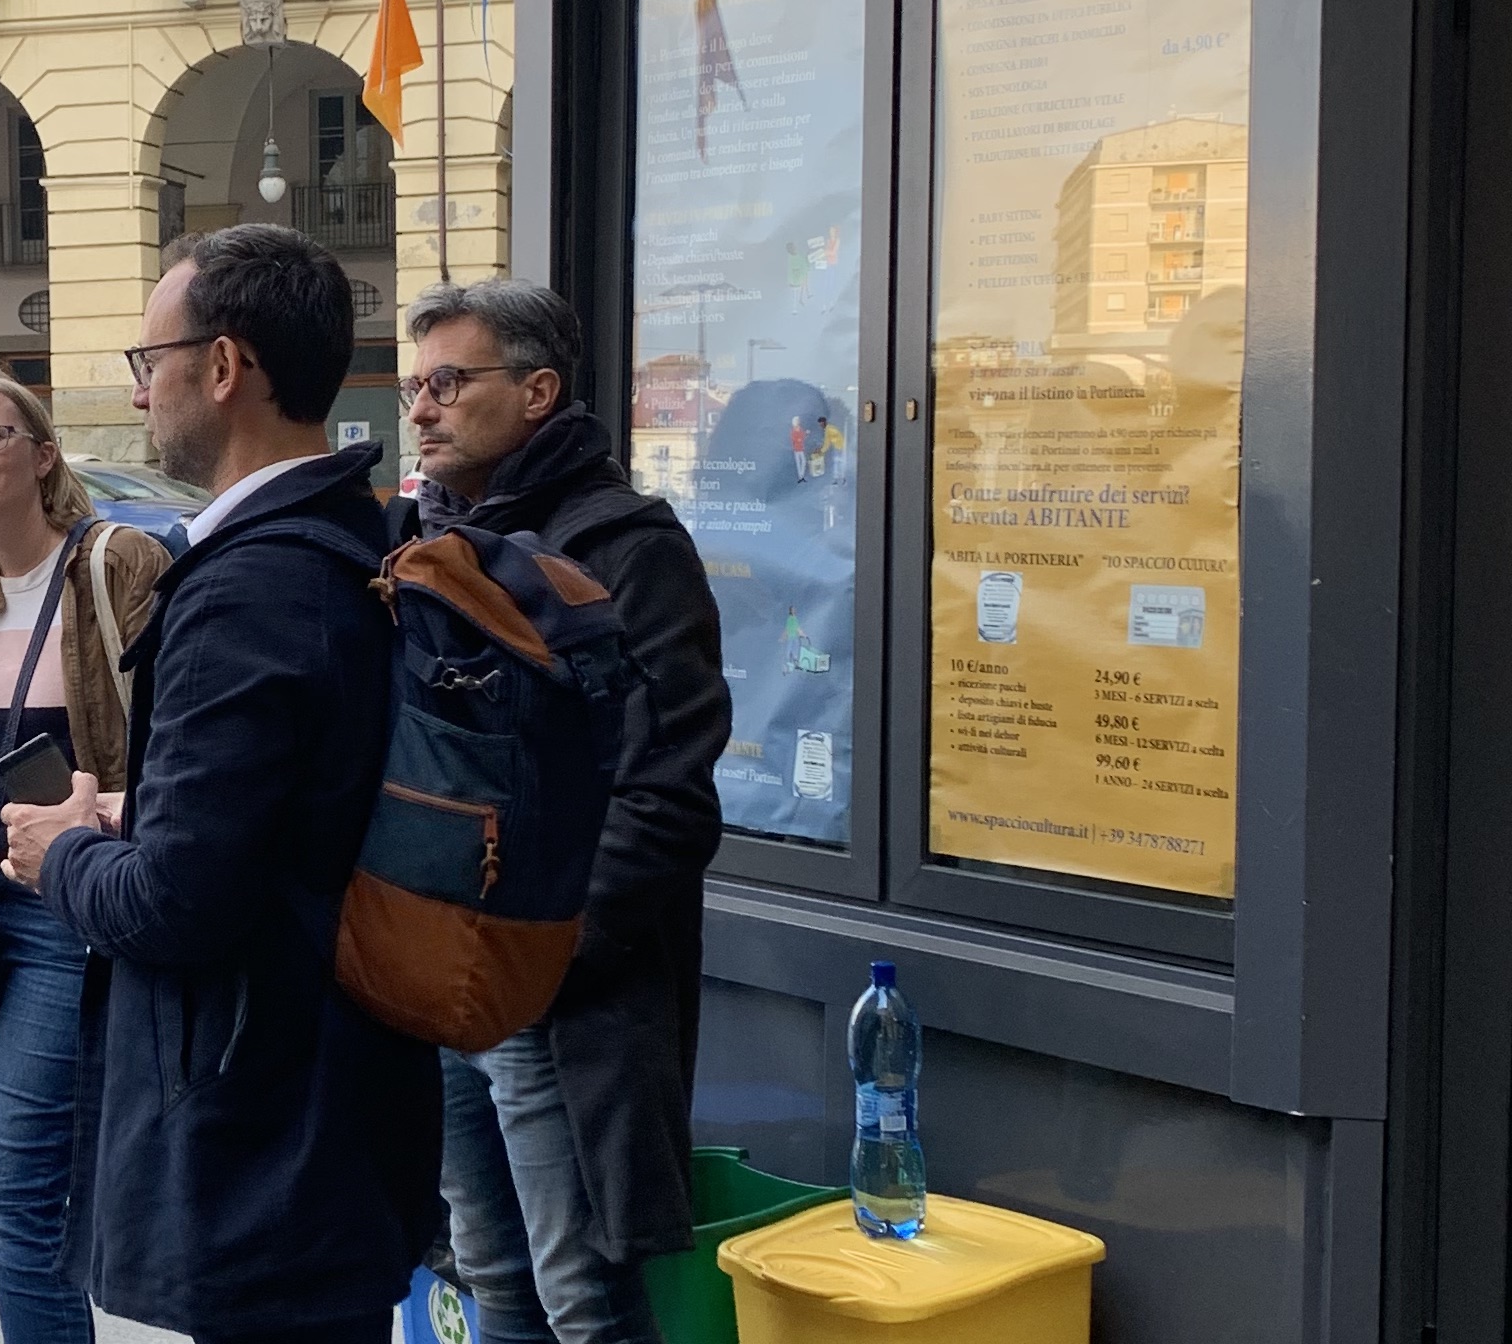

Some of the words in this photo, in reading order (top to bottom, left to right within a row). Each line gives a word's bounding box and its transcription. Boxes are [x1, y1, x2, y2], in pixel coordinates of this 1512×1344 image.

[967, 13, 1035, 32] COMMISSIONI
[1088, 1, 1132, 17] PUBBLICI
[719, 38, 747, 53] luogo
[749, 32, 773, 46] dove
[967, 38, 1018, 54] CONSEGNA
[1020, 34, 1060, 48] PACCHI
[1072, 24, 1127, 42] DOMICILIO
[1163, 38, 1178, 55] da
[1182, 34, 1212, 55] 4,90
[715, 61, 733, 76] per
[746, 50, 809, 68] commissioni
[967, 61, 1017, 76] CONSEGNA
[1019, 57, 1049, 70] FIORI
[772, 69, 816, 85] relazioni
[968, 87, 985, 98] SOS
[986, 80, 1048, 96] TECNOLOGIA
[762, 94, 785, 107] sulla
[970, 104, 1020, 120] REDAZIONE
[1022, 97, 1092, 114] CURRICULUM
[1094, 93, 1125, 106] VITAE
[720, 121, 729, 134] di
[732, 116, 793, 133] riferimento
[795, 113, 812, 128] per
[971, 127, 1005, 142] PICCOLI
[1006, 123, 1041, 138] LAVORI
[1043, 122, 1055, 134] DI
[1057, 116, 1116, 133] BRICOLAGE
[718, 140, 758, 155] rendere
[761, 134, 804, 153] possibile
[973, 148, 1029, 164] TRADUZIONE
[1043, 143, 1068, 156] TESTI
[702, 163, 758, 179] competenze
[769, 156, 803, 172] bisogni
[978, 211, 1006, 224] BABY
[1006, 208, 1041, 222] SITTING
[689, 228, 718, 247] pacchi
[978, 234, 997, 246] PET
[998, 231, 1035, 244] SITTING
[978, 254, 1039, 267] RIPETIZIONI
[673, 268, 724, 284] tecnologia
[977, 276, 1018, 289] PULIZIE
[1021, 276, 1032, 287] IN
[689, 310, 724, 324] dehors
[969, 385, 1015, 401] visiona
[1019, 385, 1029, 400] il
[1031, 385, 1074, 401] listino
[1076, 385, 1087, 399] in
[1090, 384, 1146, 399] Portineria
[1058, 429, 1096, 443] partono
[1129, 430, 1148, 440] euro
[1150, 430, 1165, 443] per
[1167, 428, 1202, 440] richieste
[1204, 428, 1218, 442] più
[1041, 444, 1081, 456] Portinai
[1133, 444, 1153, 456] mail
[703, 457, 756, 475] tecnologica
[1053, 462, 1071, 475] per
[1072, 462, 1112, 473] ottenere
[700, 478, 720, 490] fiori
[950, 482, 1002, 501] Come
[1006, 483, 1094, 503] usufruire
[1099, 484, 1127, 504] dei
[1132, 485, 1191, 505] servizi?
[698, 501, 723, 514] spesa
[733, 498, 766, 515] pacchi
[951, 506, 1018, 526] Diventa
[1023, 507, 1131, 528] ABITANTE
[705, 519, 732, 530] aiuto
[733, 519, 772, 535] compiti
[986, 552, 1002, 564] LA
[1122, 556, 1175, 570] SPACCIO
[951, 659, 964, 672] 10
[967, 659, 1009, 675] €/anno
[958, 678, 997, 690] ricezione
[999, 681, 1027, 694] pacchi
[1095, 669, 1130, 686] 24,90
[1133, 672, 1142, 686] €
[958, 694, 994, 707] deposito
[996, 696, 1022, 709] chiavi
[1030, 700, 1053, 711] buste
[1101, 689, 1127, 702] MESI
[1143, 693, 1185, 707] SERVIZI
[1195, 697, 1219, 710] scelta
[957, 709, 975, 721] lista
[977, 713, 1015, 726] artigiani
[1017, 714, 1026, 725] di
[1028, 716, 1057, 728] fiducia
[1095, 714, 1129, 730] 49,80
[1131, 716, 1140, 731] €
[958, 742, 989, 754] attività
[990, 746, 1028, 758] culturali
[1103, 735, 1128, 747] MESI
[1136, 738, 1148, 749] 12
[1149, 739, 1190, 753] SERVIZI
[1199, 745, 1225, 757] scelta
[1096, 754, 1130, 771] 99,60
[1133, 757, 1142, 772] €
[1103, 775, 1131, 787] ANNO
[1142, 779, 1153, 790] 24
[1155, 781, 1194, 796] SERVIZI
[1203, 787, 1230, 800] scelta
[948, 810, 1090, 841] www.spacciocultura.it
[1100, 828, 1125, 844] +39
[1127, 831, 1206, 856] 3478788271
